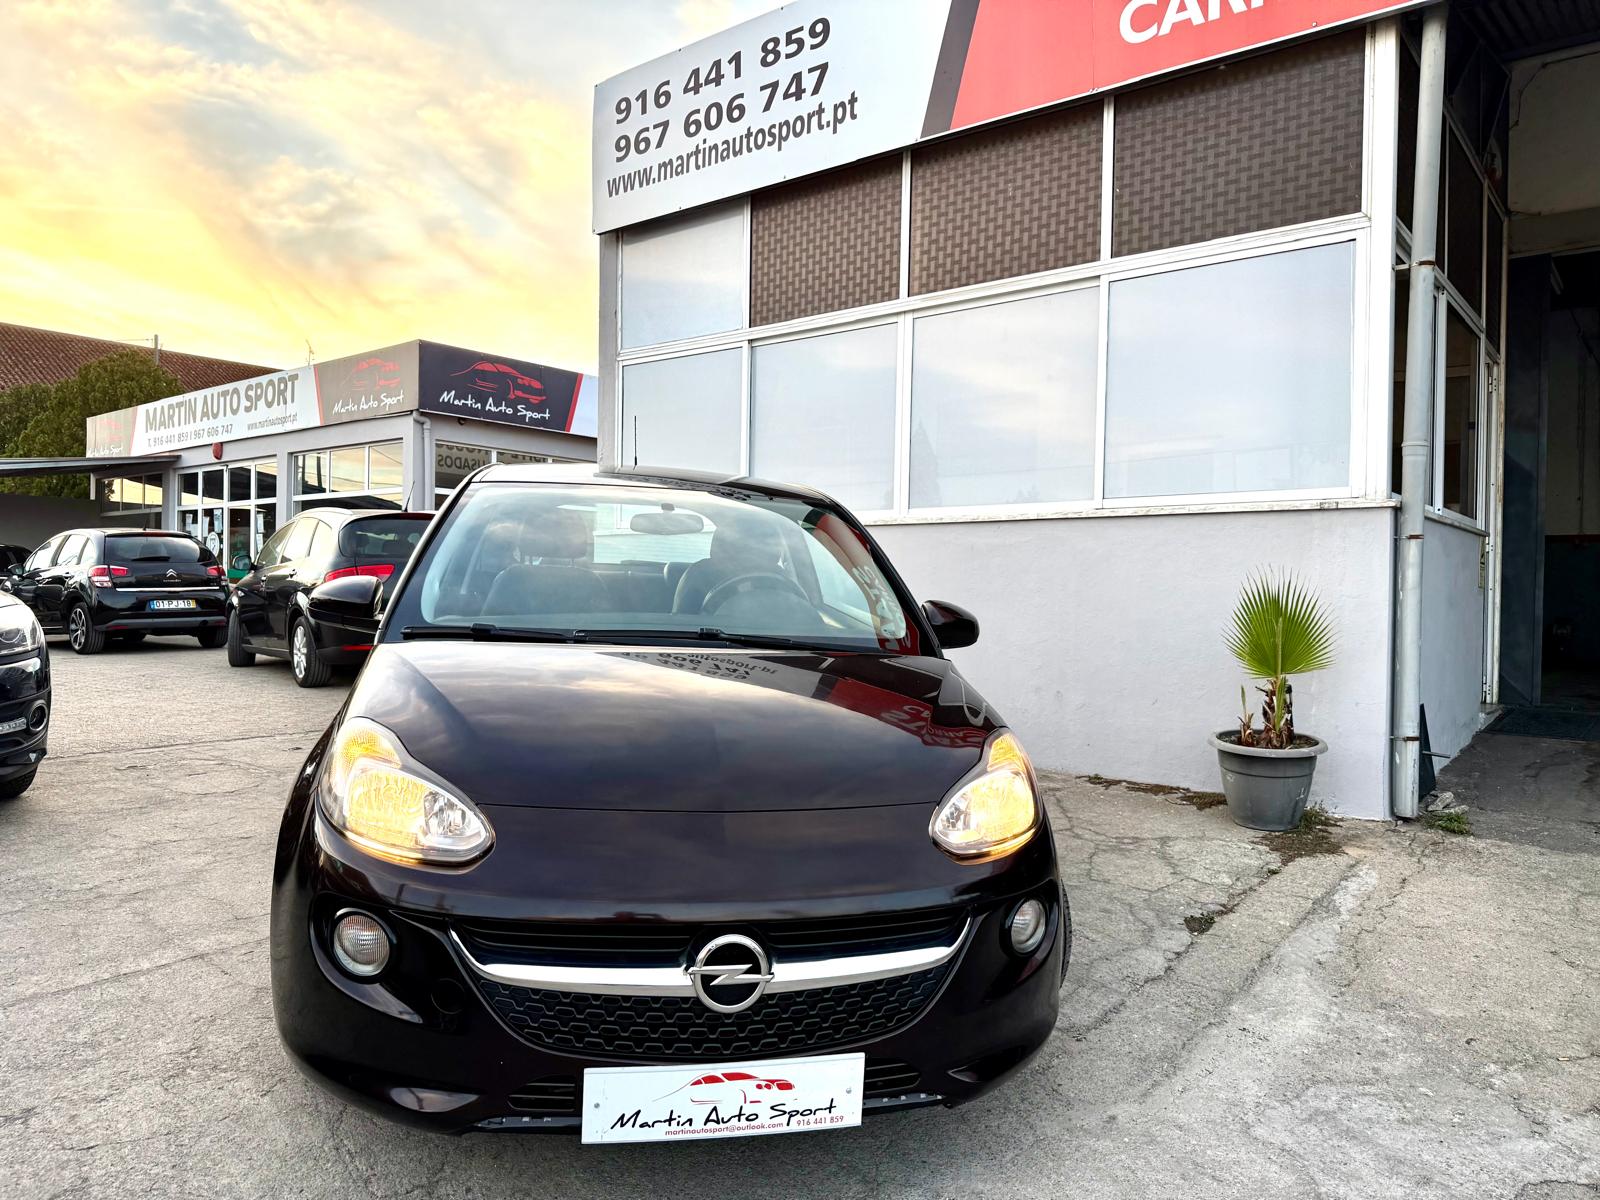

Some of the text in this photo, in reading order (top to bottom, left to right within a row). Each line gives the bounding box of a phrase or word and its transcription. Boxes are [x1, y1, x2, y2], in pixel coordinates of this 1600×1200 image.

[615, 17, 831, 124] 916 441 859
[615, 62, 829, 163] 967 606 747
[607, 90, 858, 198] www.martinautosport.pt
[145, 373, 299, 433] MARTIN AUTO SPORT
[333, 389, 404, 416] Martin Auto Sport
[439, 390, 551, 422] Martin Auto Sport
[153, 435, 164, 447] 916
[165, 434, 175, 444] 441
[177, 431, 188, 443] 859
[194, 429, 205, 440] 967
[207, 426, 219, 438] 606
[221, 423, 233, 436] 747
[610, 1098, 837, 1130] Martin Auto Sport
[665, 1115, 844, 1136] martinautosport@outlook.com 916 441 859
